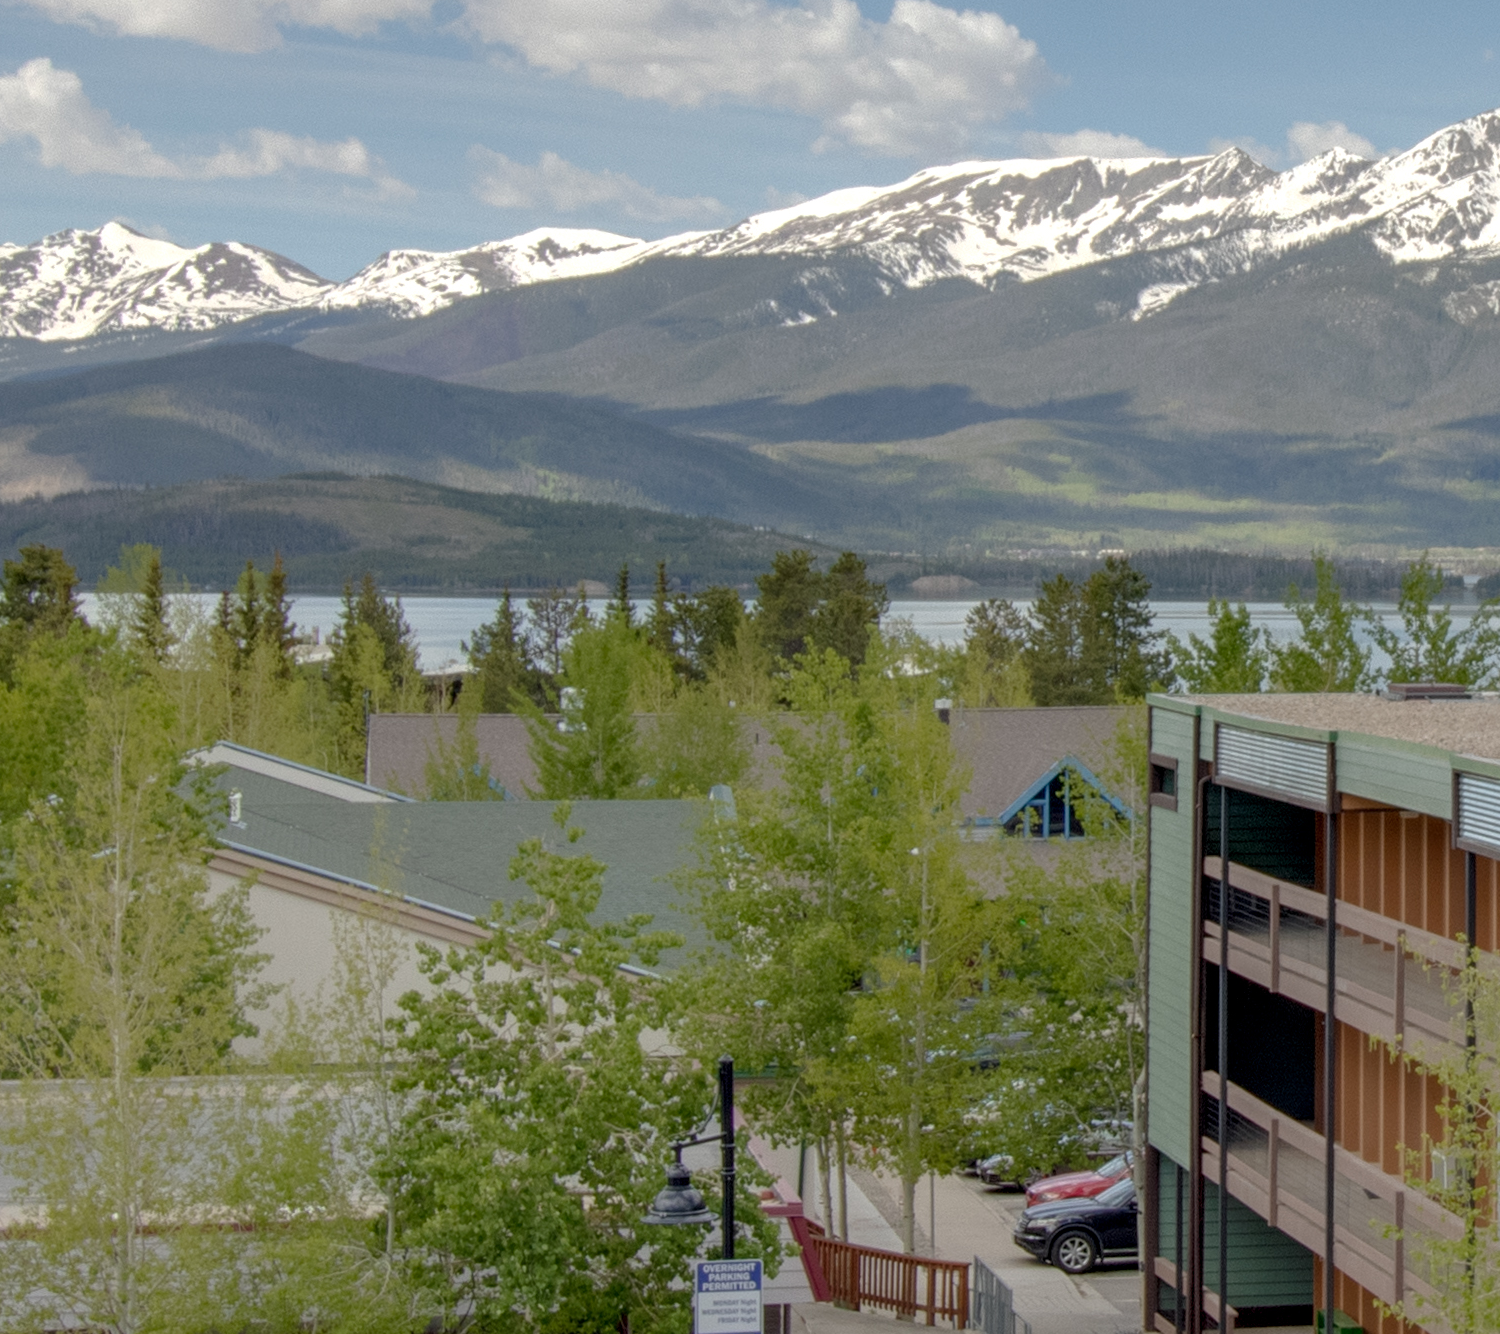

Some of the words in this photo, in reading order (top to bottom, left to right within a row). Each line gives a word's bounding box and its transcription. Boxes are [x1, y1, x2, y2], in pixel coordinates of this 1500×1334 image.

[702, 1263, 756, 1273] OVERNIGHT
[708, 1272, 750, 1282] PARKING
[702, 1281, 757, 1291] PERMITTED
